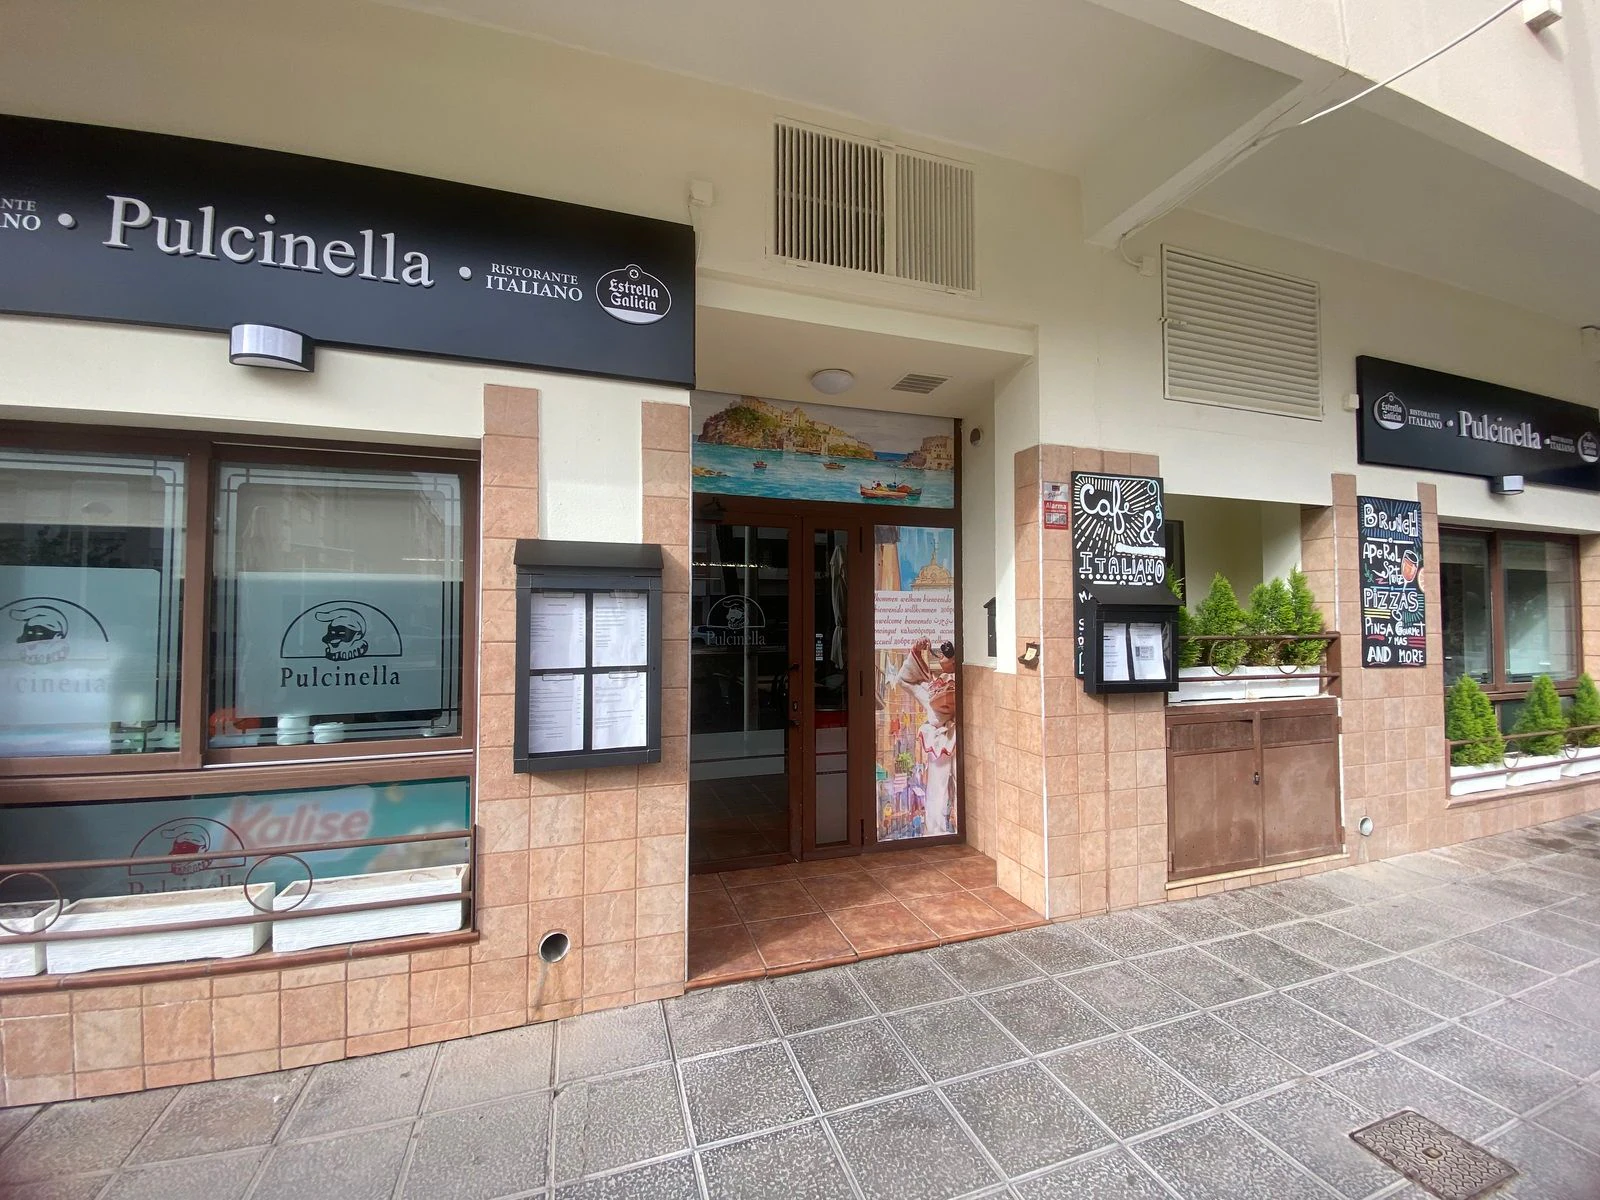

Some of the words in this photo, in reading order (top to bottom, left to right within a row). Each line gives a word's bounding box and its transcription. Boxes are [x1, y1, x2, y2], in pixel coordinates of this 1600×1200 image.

[0, 213, 41, 230] NO
[102, 194, 435, 288] Pulcinella
[491, 263, 579, 285] RISTORANTE
[485, 274, 583, 302] ITALIANO
[609, 278, 659, 298] Estrella
[610, 292, 657, 311] Galicia
[1408, 416, 1443, 429] ITALIANO
[1457, 410, 1542, 449] Pulcinella
[1363, 503, 1419, 537] BRUNCH
[1367, 646, 1392, 663] AND
[1398, 648, 1424, 663] MORE
[280, 665, 400, 688] Pulcinella
[222, 797, 370, 852] Kalise
